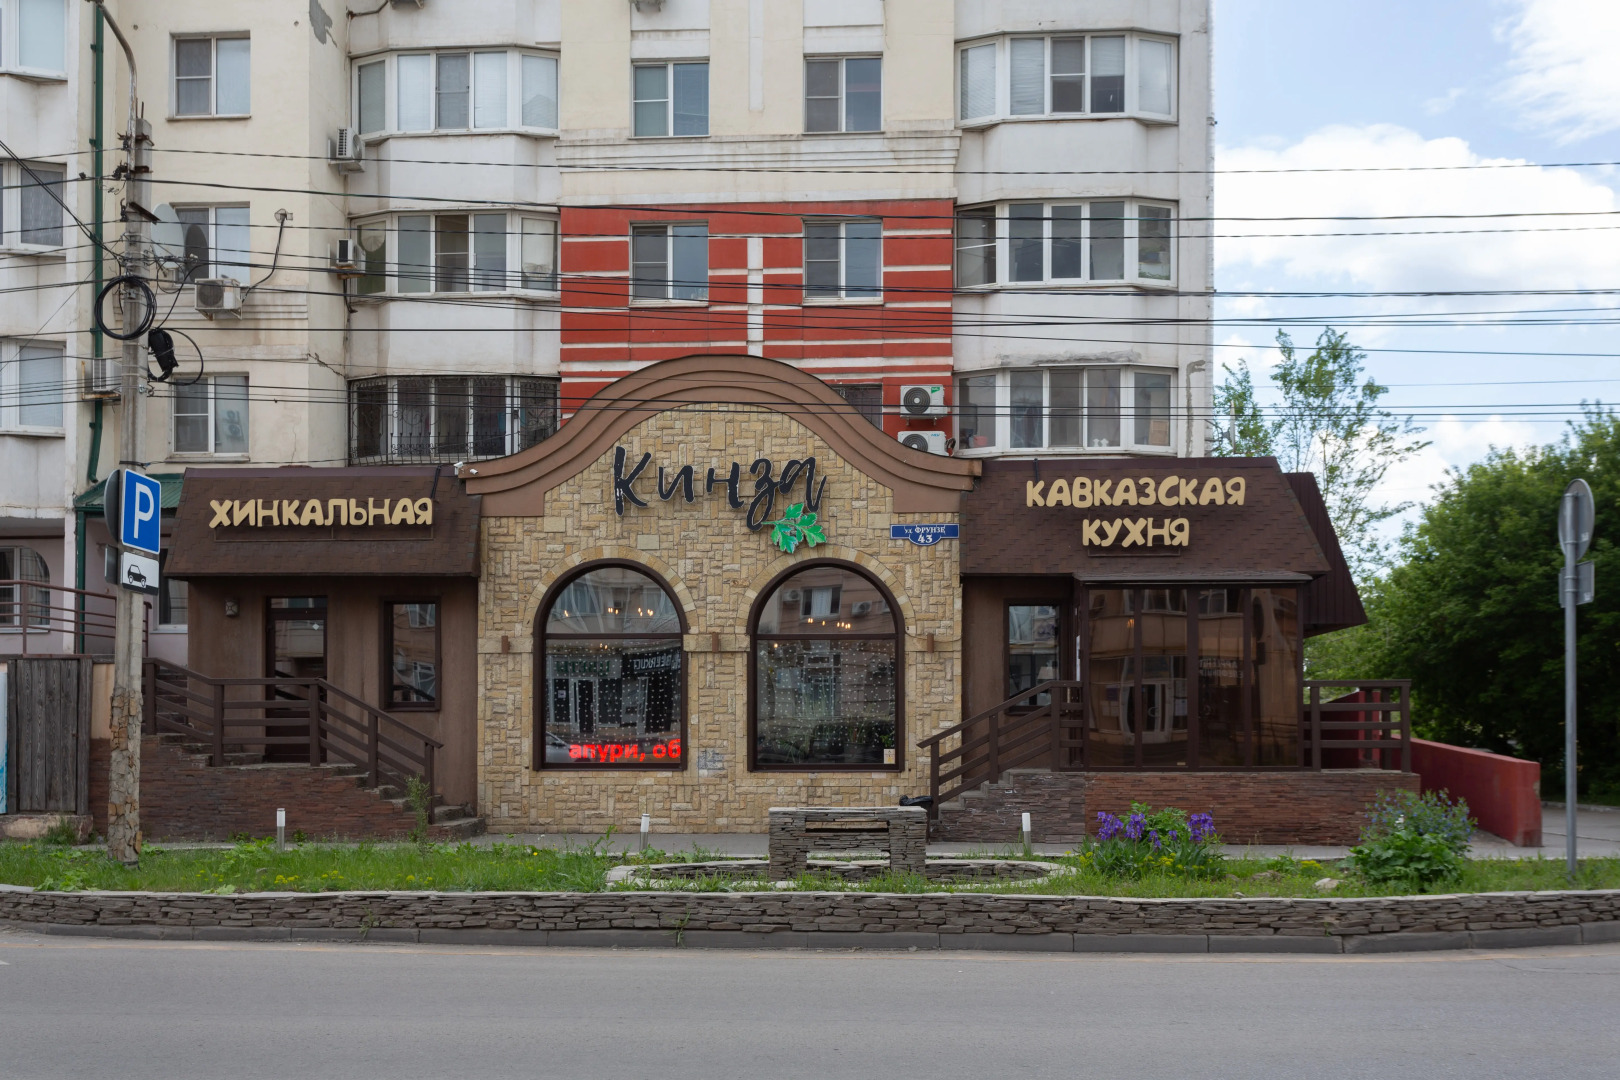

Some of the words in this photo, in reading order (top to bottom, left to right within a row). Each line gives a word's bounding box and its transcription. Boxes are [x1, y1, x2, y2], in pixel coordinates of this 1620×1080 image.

[614, 446, 827, 531] Кинза
[1026, 475, 1246, 508] КАВКАЗСКАЯ
[133, 482, 154, 539] P
[209, 497, 433, 528] ХИНКАЛЬНАЯ
[915, 526, 946, 534] ФРУНЗЕ
[918, 534, 933, 544] 43
[1082, 517, 1190, 548] КУХНЯ
[569, 744, 646, 762] апури,
[652, 738, 681, 758] об
